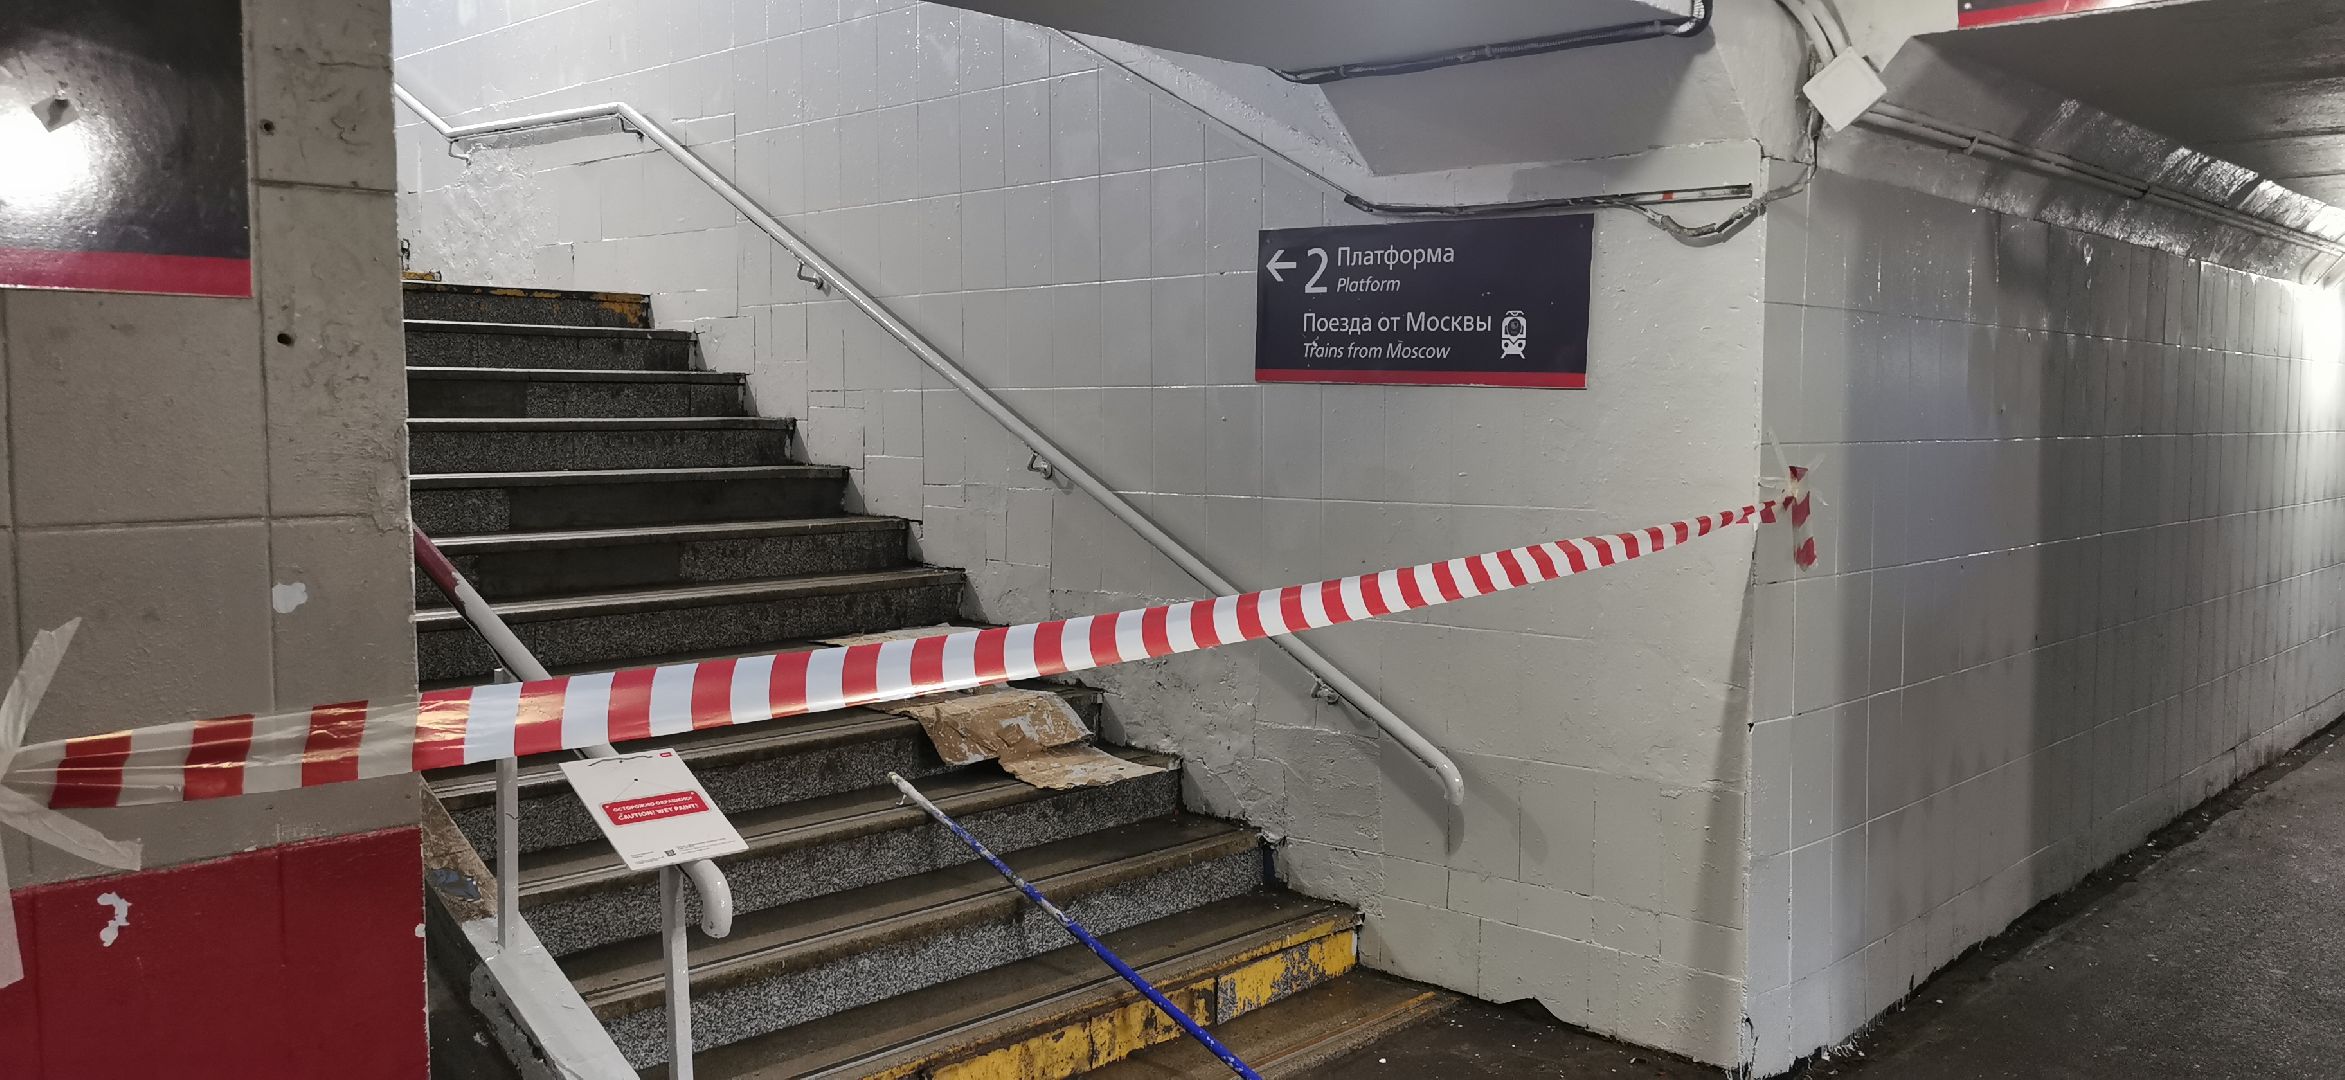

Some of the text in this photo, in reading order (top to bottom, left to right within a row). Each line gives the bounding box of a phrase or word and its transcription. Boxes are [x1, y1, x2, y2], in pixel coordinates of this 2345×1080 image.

[1337, 245, 1455, 270] Платформа
[1304, 247, 1329, 294] 2
[1336, 276, 1401, 293] Platform
[1303, 311, 1492, 335] Поезда от Москвы
[1303, 340, 1451, 361] Trains from Moscow
[618, 809, 655, 820] CAUTION!
[656, 807, 673, 815] WET
